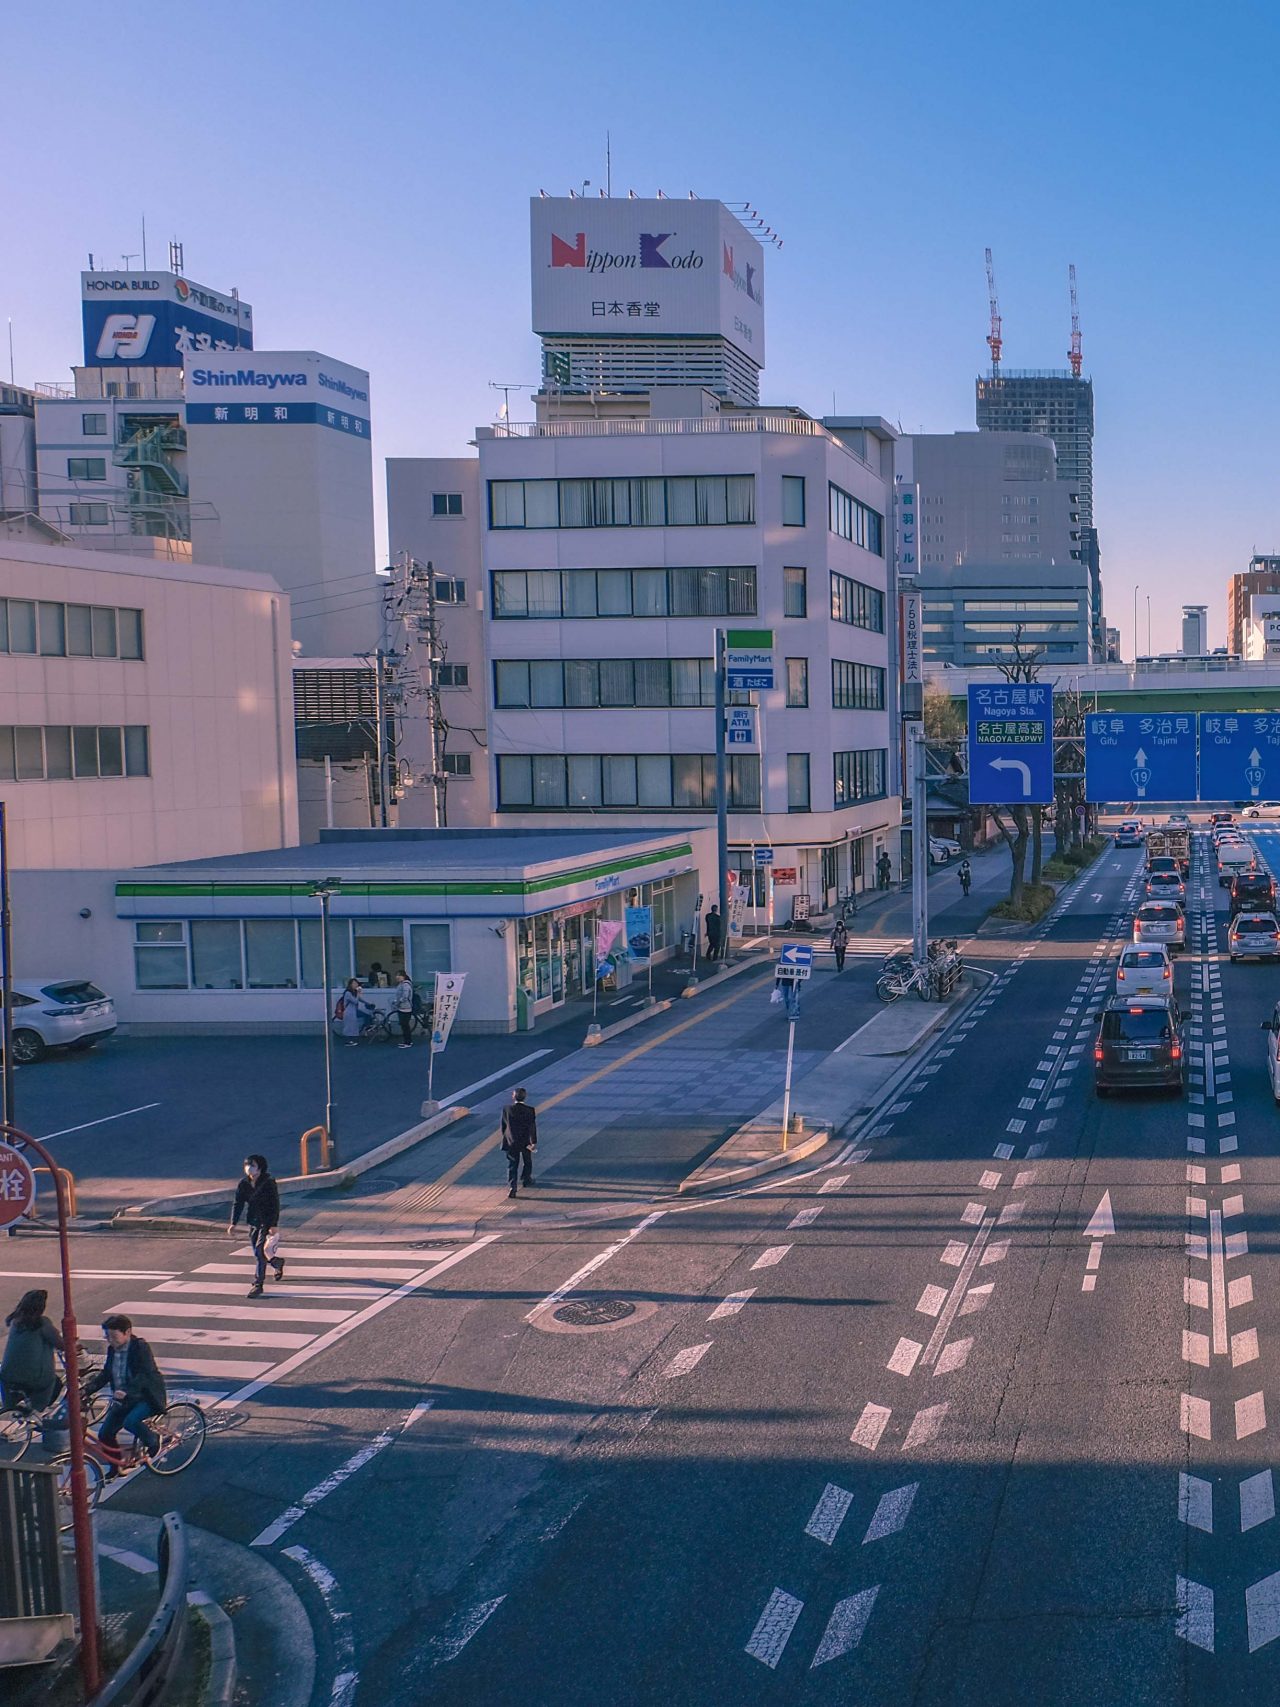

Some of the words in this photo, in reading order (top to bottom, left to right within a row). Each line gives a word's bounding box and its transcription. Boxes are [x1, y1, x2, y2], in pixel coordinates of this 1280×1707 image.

[551, 232, 639, 274] Nippon
[640, 232, 704, 269] Kodo
[86, 280, 130, 291] HONDA
[131, 280, 160, 291] BUILD
[591, 301, 662, 318] 日本香堂
[192, 370, 308, 390] ShinMaywa
[318, 372, 368, 402] ShinMaywa
[214, 406, 288, 421] 新明和
[902, 492, 914, 564] 音羽ビル
[907, 599, 918, 680] 758税理士法人
[728, 654, 772, 665] FamilyMart
[975, 688, 1046, 705] 名古屋駅
[984, 706, 1016, 718] Nagoya
[1019, 706, 1036, 716] Sta.
[731, 719, 750, 727] ATM
[979, 722, 1043, 735] 名古屋高速
[1091, 718, 1125, 735] 岐阜
[1139, 718, 1190, 735] 多治見
[1204, 718, 1238, 735] 岐阜
[978, 735, 1012, 743] NAGOYA
[1015, 735, 1043, 743] EXPWY
[1100, 736, 1118, 745] Gifu
[1152, 736, 1178, 745] Tajimi
[1214, 736, 1232, 745] Gifu
[1135, 771, 1148, 782] 19
[1248, 771, 1261, 782] 19
